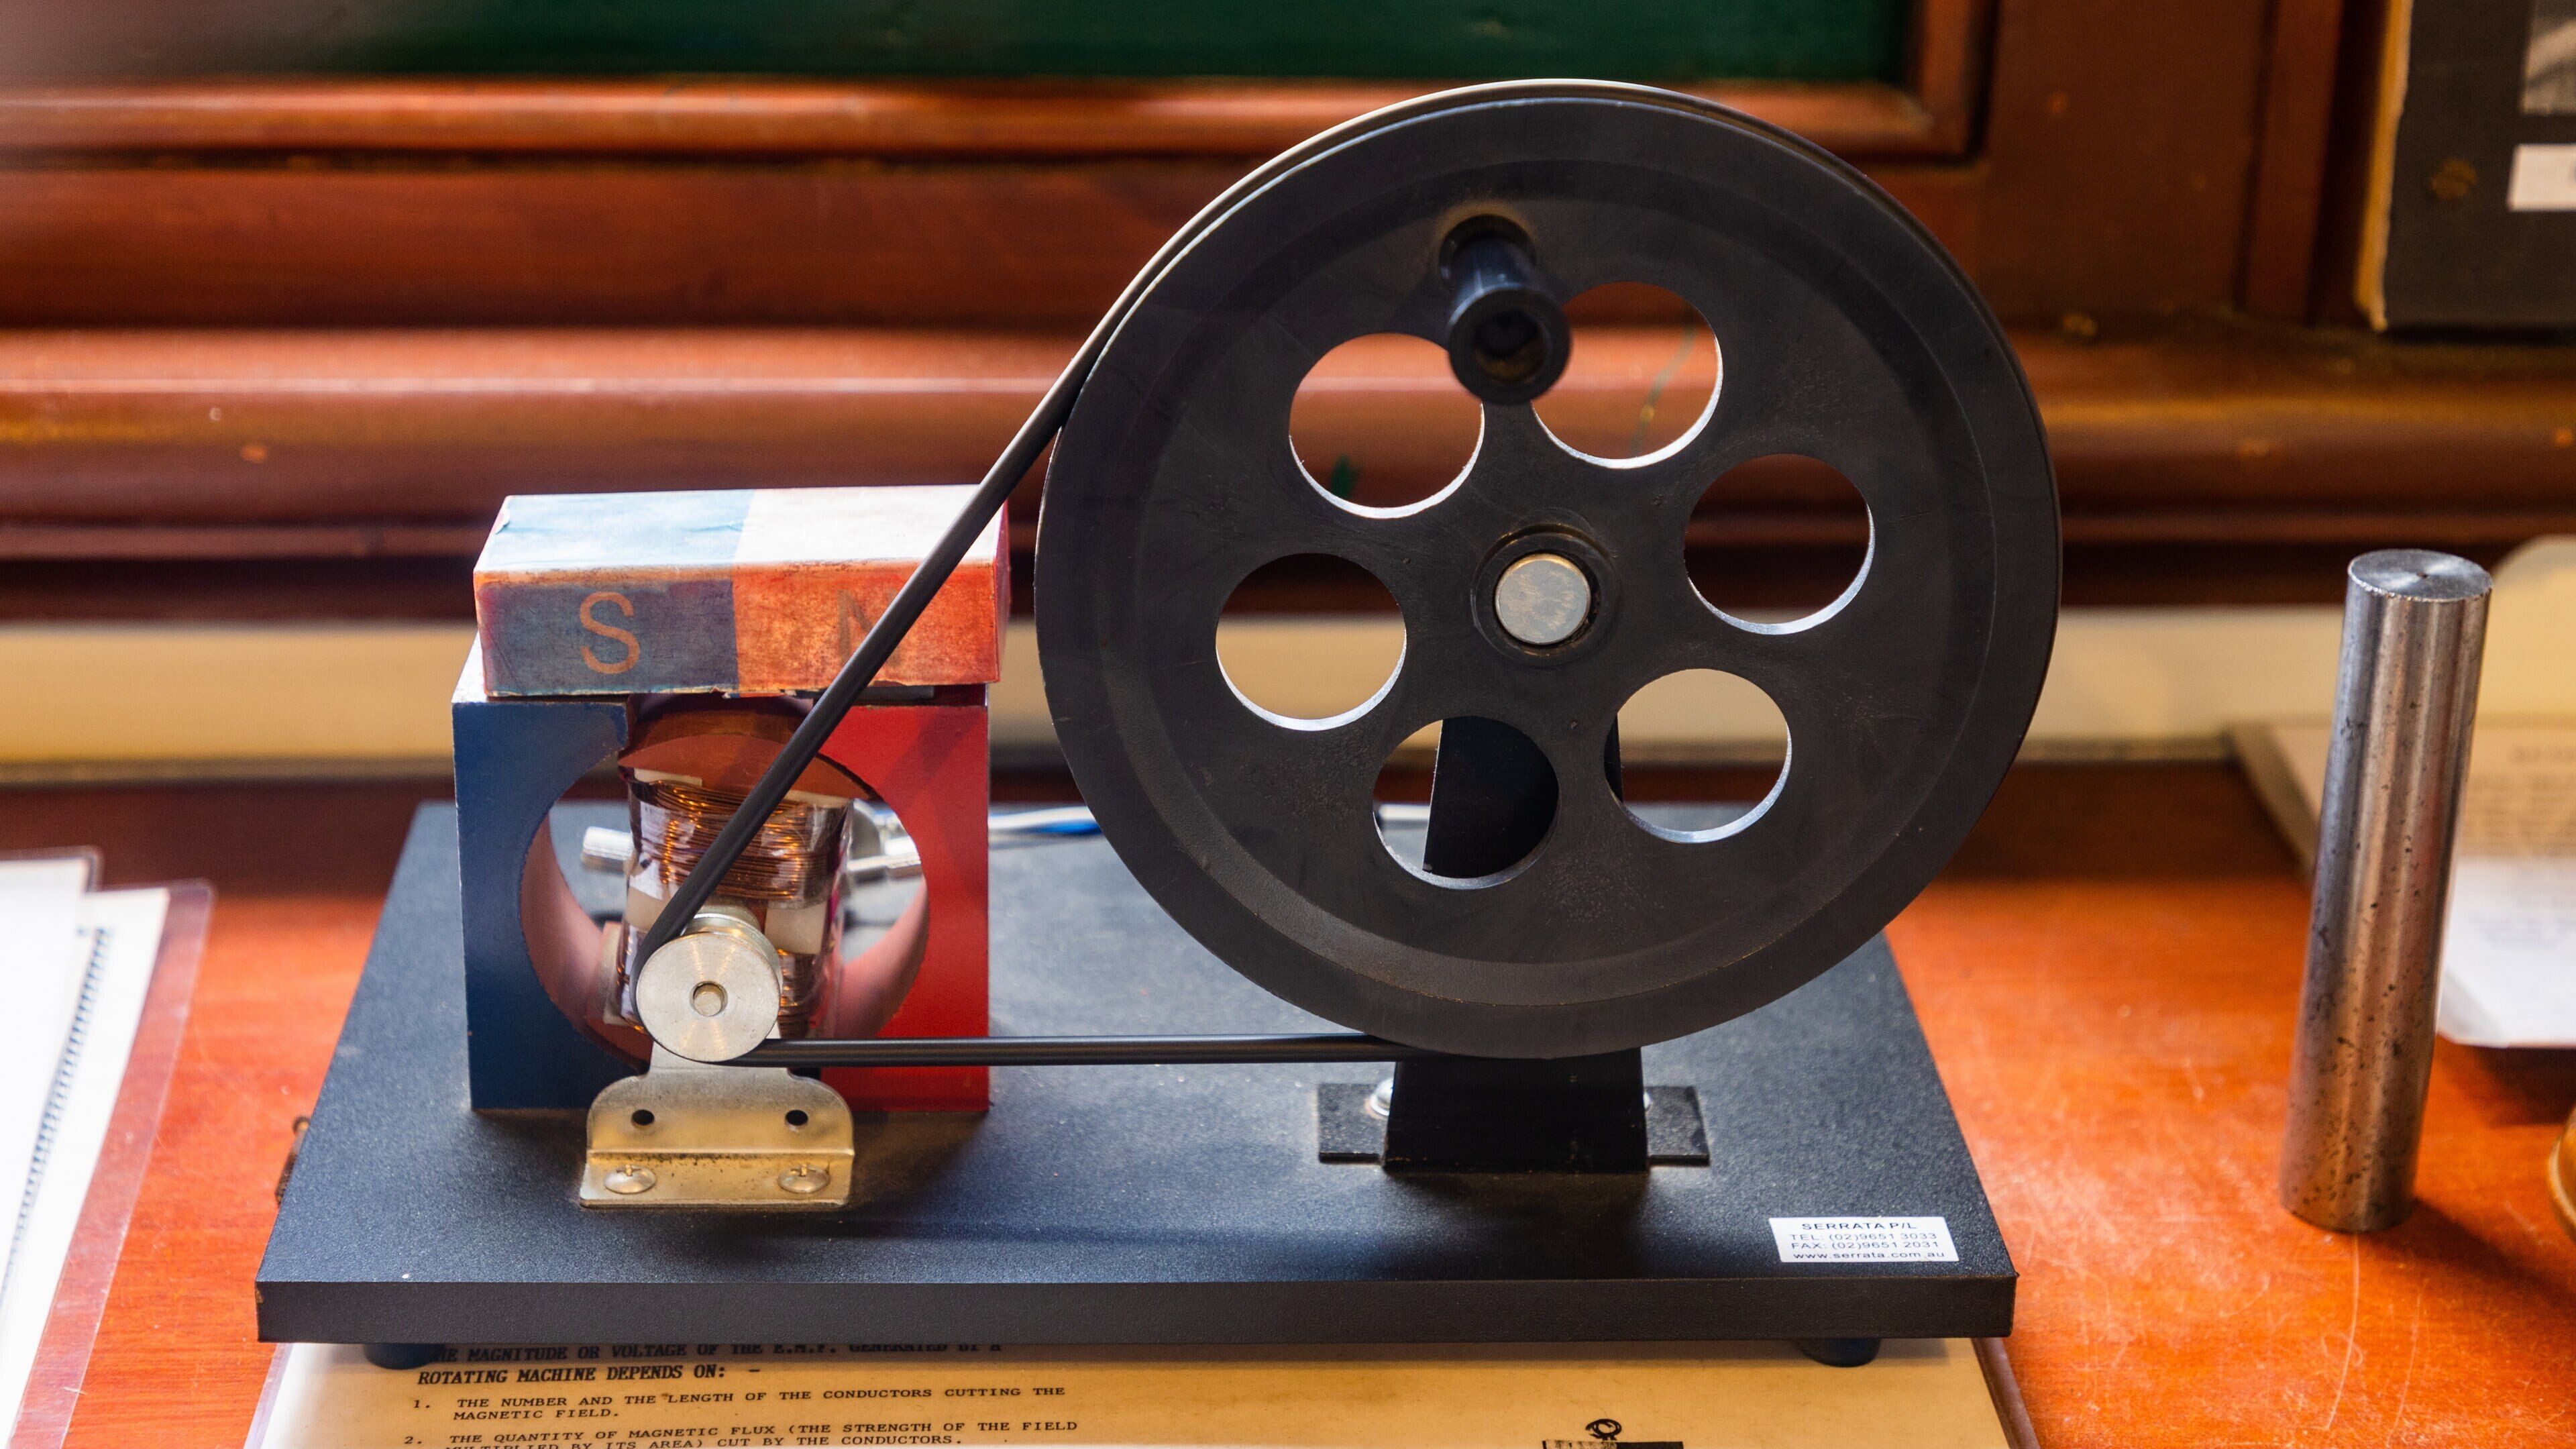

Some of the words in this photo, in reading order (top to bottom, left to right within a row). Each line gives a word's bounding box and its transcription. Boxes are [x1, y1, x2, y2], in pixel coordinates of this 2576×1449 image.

[580, 590, 641, 675] S
[1802, 1222, 1885, 1230] SERRATA
[1900, 1232, 1937, 1240] 3033
[1793, 1250, 1945, 1260] www.serrata.com.au
[468, 1346, 568, 1362] MAGNITUDE
[578, 1346, 600, 1360] OR
[611, 1344, 687, 1358] VOLTAGE
[697, 1343, 719, 1356] OF
[731, 1343, 763, 1354] THE
[417, 1369, 508, 1385] ROTATING
[517, 1367, 596, 1382] MACHINE
[606, 1365, 683, 1381] DEPENDS
[694, 1364, 726, 1379] ON:
[413, 1399, 430, 1408] 1.
[457, 1399, 489, 1407] THE
[501, 1397, 567, 1407] NUMBER
[579, 1396, 612, 1405] AND
[625, 1395, 656, 1404] THE
[667, 1393, 734, 1403] LENGTH
[745, 1392, 767, 1401] OF
[779, 1391, 812, 1400] THE
[823, 1389, 932, 1399] CONDUCTORS
[945, 1388, 1021, 1397] CUTTING
[1032, 1387, 1065, 1395] THE
[453, 1410, 543, 1420] MAGNETIC
[555, 1409, 619, 1418] FIELD.
[404, 1436, 422, 1444] 2.
[449, 1435, 482, 1444] THE
[494, 1432, 584, 1442] QUANTITY
[595, 1431, 617, 1440] OF
[628, 1428, 718, 1438] MAGNETIC
[731, 1426, 775, 1435] FLUX
[788, 1425, 831, 1434] (THE
[843, 1423, 932, 1434] STRENGTH
[943, 1423, 965, 1432] OF
[977, 1422, 1010, 1431] THE
[1022, 1421, 1077, 1431] FIELD
[649, 1440, 703, 1449] AREA)
[717, 1438, 751, 1447] CUT
[763, 1438, 784, 1446] BY
[796, 1437, 829, 1446] THE
[841, 1436, 961, 1445] CONDUCTORS.
